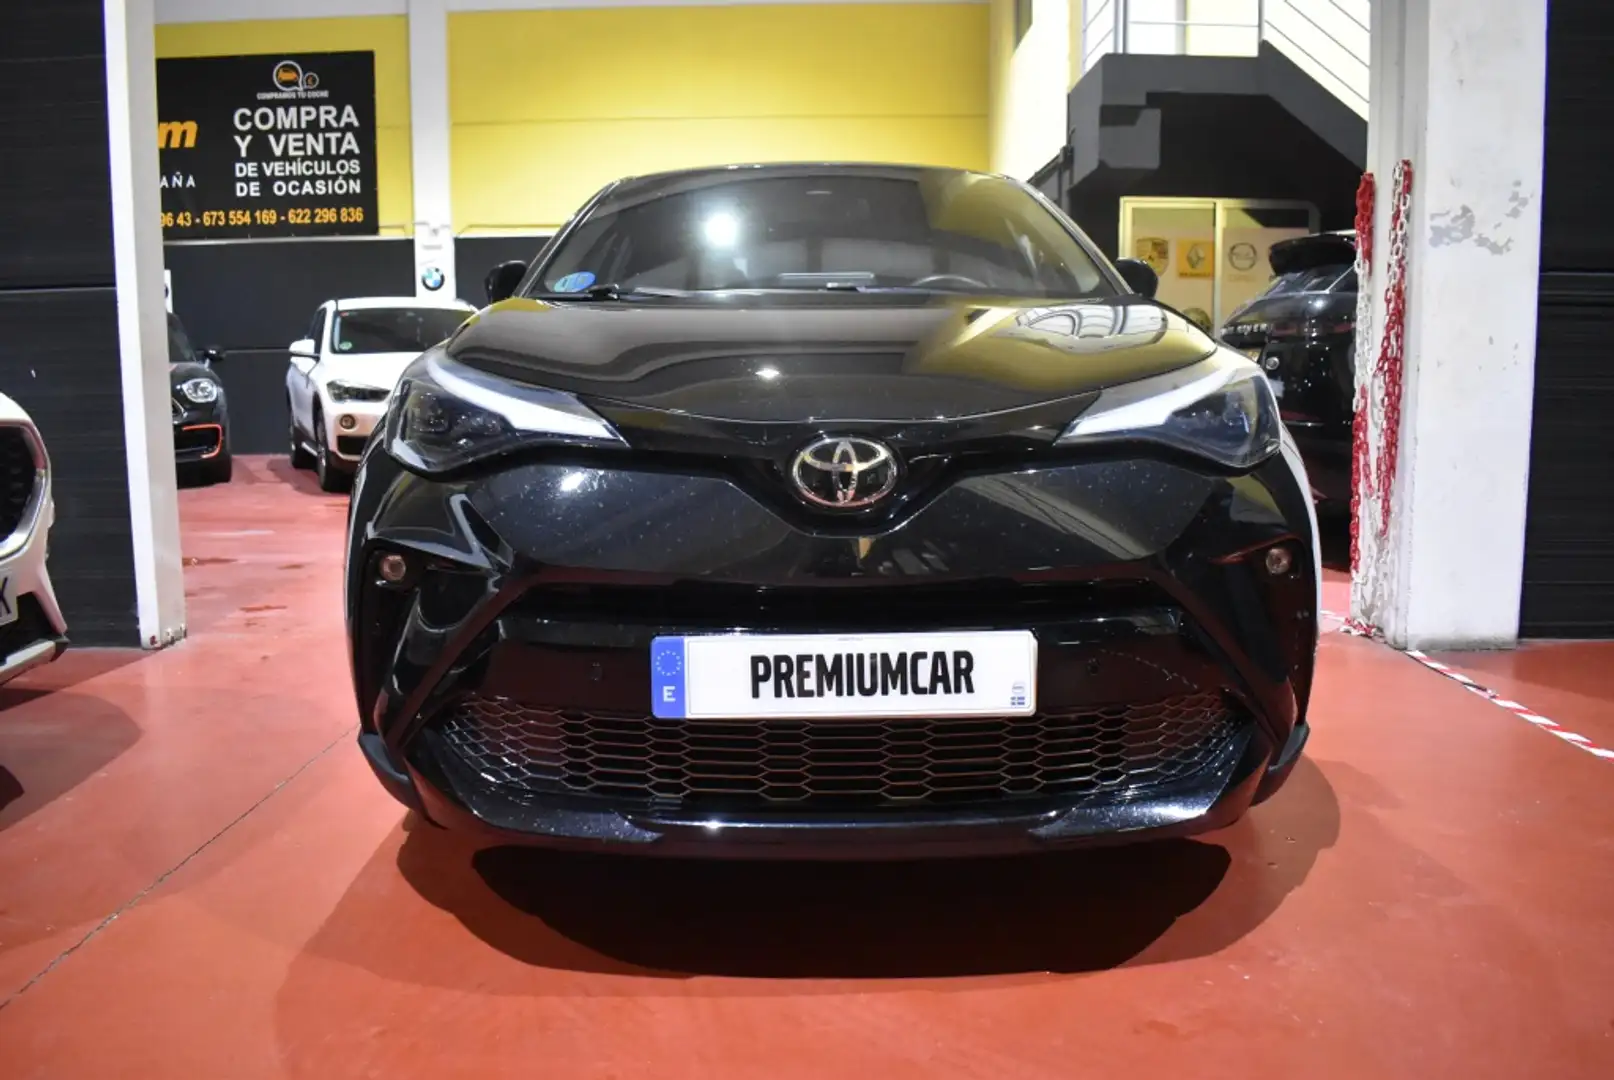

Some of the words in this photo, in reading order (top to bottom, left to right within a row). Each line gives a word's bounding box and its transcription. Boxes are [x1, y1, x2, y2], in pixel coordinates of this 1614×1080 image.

[233, 105, 360, 131] COMPRA
[234, 134, 253, 159] Y
[268, 131, 361, 158] VENTA
[235, 161, 259, 178] DE
[262, 156, 361, 177] VEHÍCULOS
[235, 181, 262, 197] DE
[273, 175, 362, 197] OCASIÓN
[176, 211, 192, 227] 43
[202, 210, 226, 226] 673
[228, 209, 252, 226] 554
[254, 208, 278, 226] 169
[287, 207, 312, 225] 622
[313, 207, 338, 224] 296
[339, 206, 364, 223] 836
[750, 650, 975, 699] PREMIUMCAR
[663, 685, 676, 702] E
